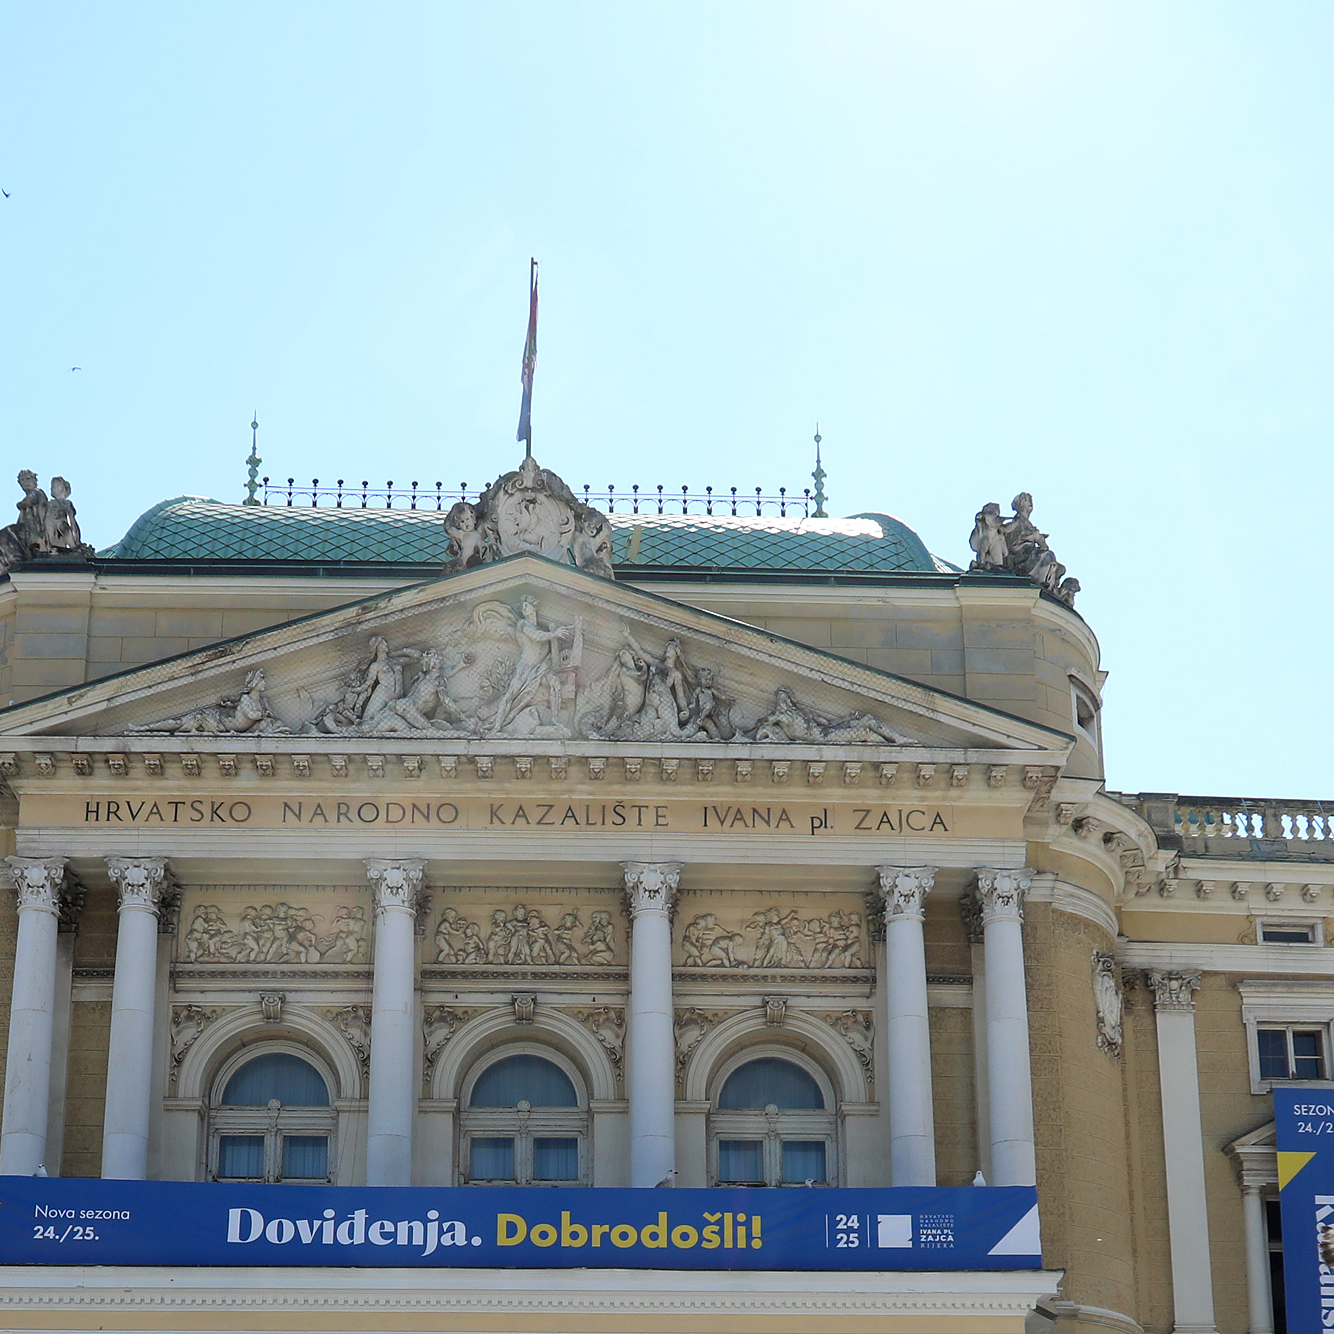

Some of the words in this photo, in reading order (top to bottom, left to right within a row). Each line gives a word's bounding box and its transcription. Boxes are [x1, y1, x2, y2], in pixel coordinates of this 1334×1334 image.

[84, 800, 252, 823] HRVATSKO
[281, 801, 460, 825] NARODNO
[488, 798, 669, 828] KAZALIŠTE
[702, 805, 796, 829] IVANA
[809, 808, 835, 836] pl.
[851, 808, 951, 834] ZAJCA
[34, 1205, 76, 1219] Nova
[79, 1208, 130, 1220] sezona
[835, 1214, 860, 1229] 24
[32, 1225, 100, 1243] 24./25.
[226, 1208, 483, 1257] Doviđenja.
[496, 1210, 764, 1250] Dobrodošli!
[835, 1233, 860, 1248] 25
